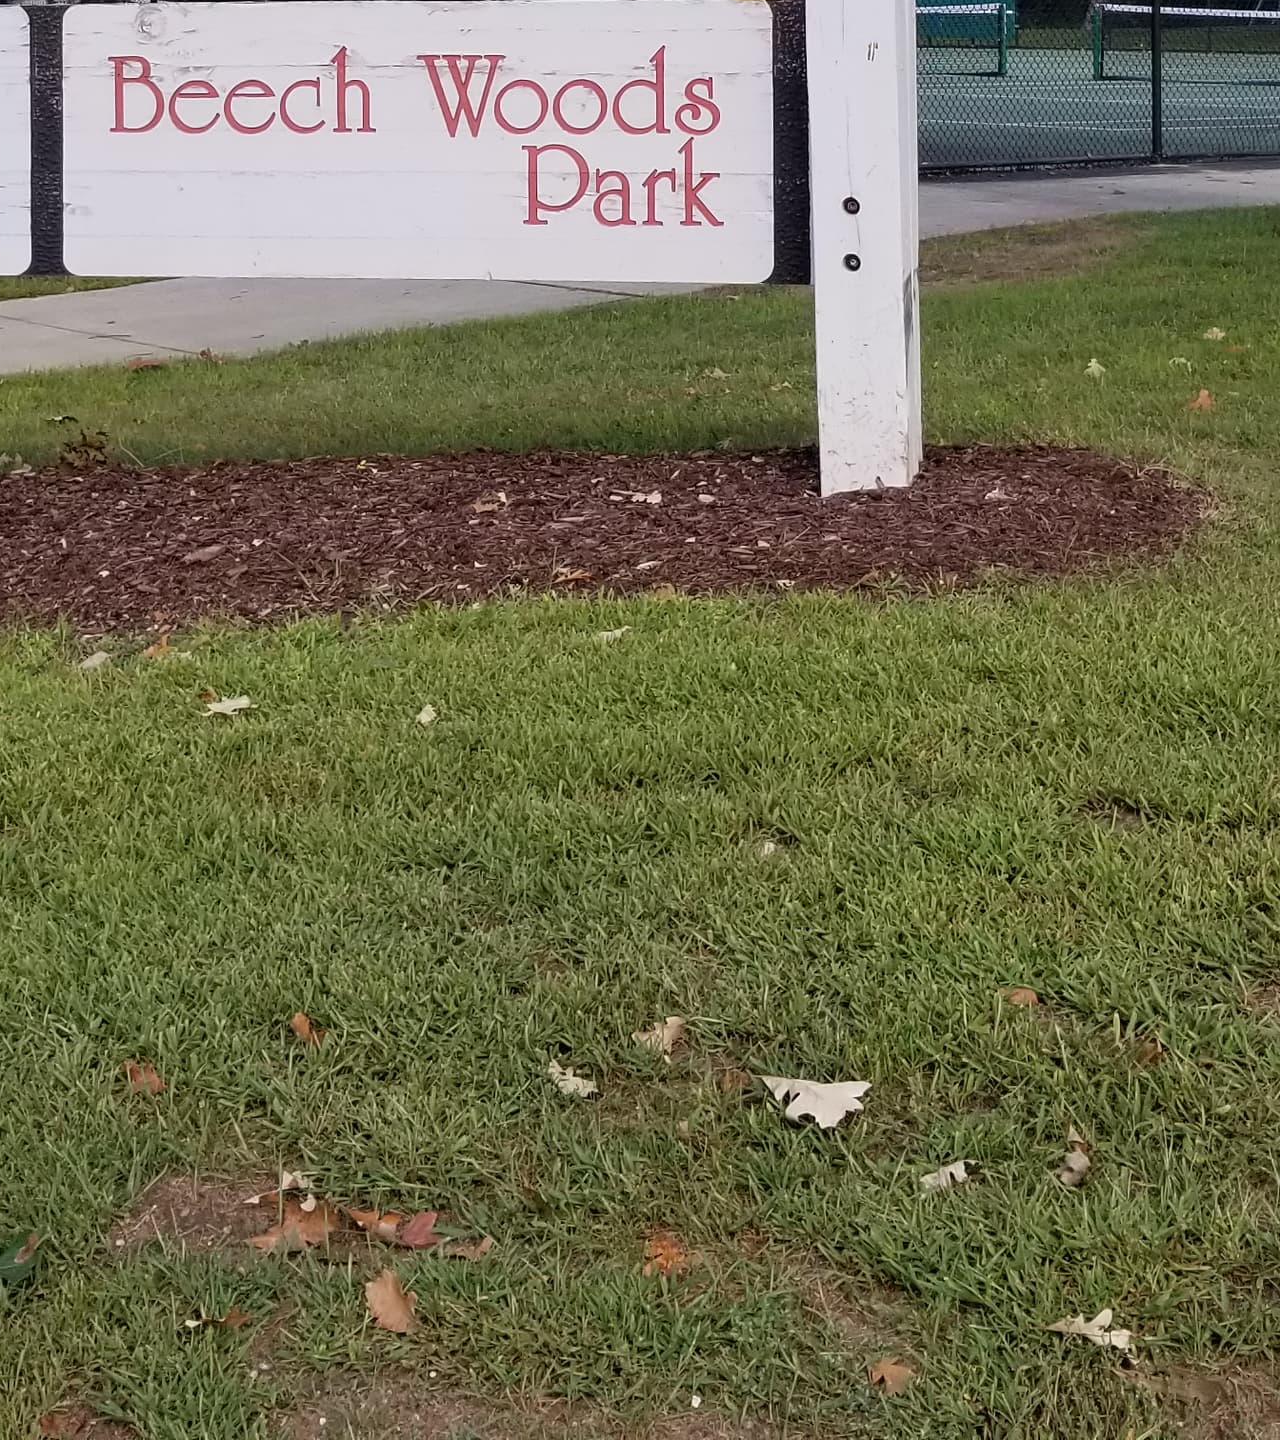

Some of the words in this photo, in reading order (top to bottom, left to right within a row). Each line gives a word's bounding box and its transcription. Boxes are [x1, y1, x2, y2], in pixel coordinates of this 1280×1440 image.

[108, 46, 377, 134] Beech
[416, 45, 721, 138] Woods
[521, 137, 725, 227] Park
